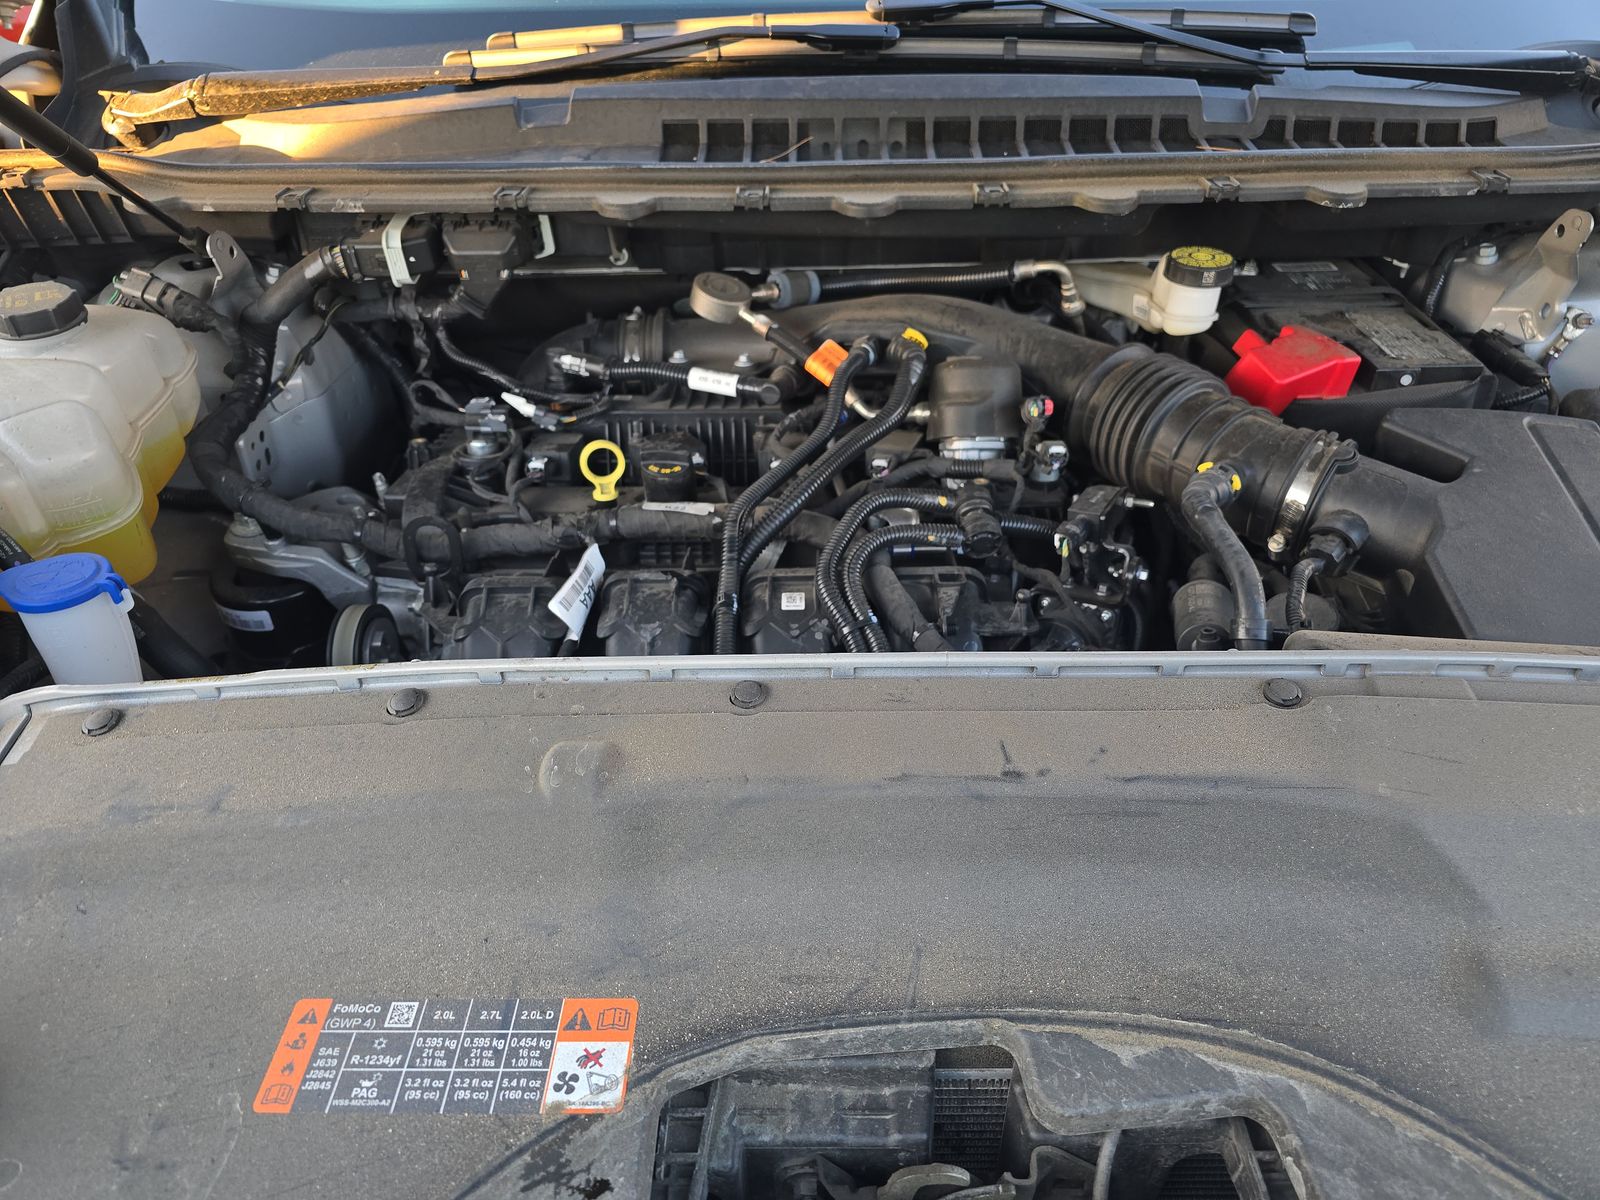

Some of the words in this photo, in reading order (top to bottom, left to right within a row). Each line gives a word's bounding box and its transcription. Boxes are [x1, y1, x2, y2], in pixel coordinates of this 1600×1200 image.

[334, 1004, 381, 1013] FoMoCo
[434, 1011, 455, 1019] 2.0L
[480, 1011, 502, 1019] 2.7L
[521, 1011, 543, 1019] 2.0L
[546, 1011, 554, 1019] D
[324, 1018, 361, 1030] (GWP
[362, 1018, 376, 1030] 4)
[417, 1038, 442, 1047] 0.595
[444, 1038, 457, 1049] kg
[464, 1038, 490, 1047] 0.595
[492, 1038, 504, 1049] kg
[511, 1038, 538, 1047] 0.454
[539, 1038, 551, 1049] kg
[319, 1048, 340, 1056] SAE
[470, 1049, 480, 1057] 21
[519, 1049, 528, 1057] 16
[350, 1055, 402, 1066] R-1234yf
[416, 1059, 431, 1067] 1.31
[434, 1059, 446, 1067] lbs
[405, 1079, 420, 1087] 3.2
[455, 1079, 470, 1087] 3.2
[502, 1079, 517, 1087] 5.4
[351, 1088, 377, 1098] PAG
[405, 1090, 421, 1100] (95
[424, 1090, 440, 1101] cc)
[454, 1090, 470, 1101] (95
[473, 1090, 488, 1101] cc)
[500, 1090, 521, 1101] (160
[525, 1090, 540, 1101] cc)
